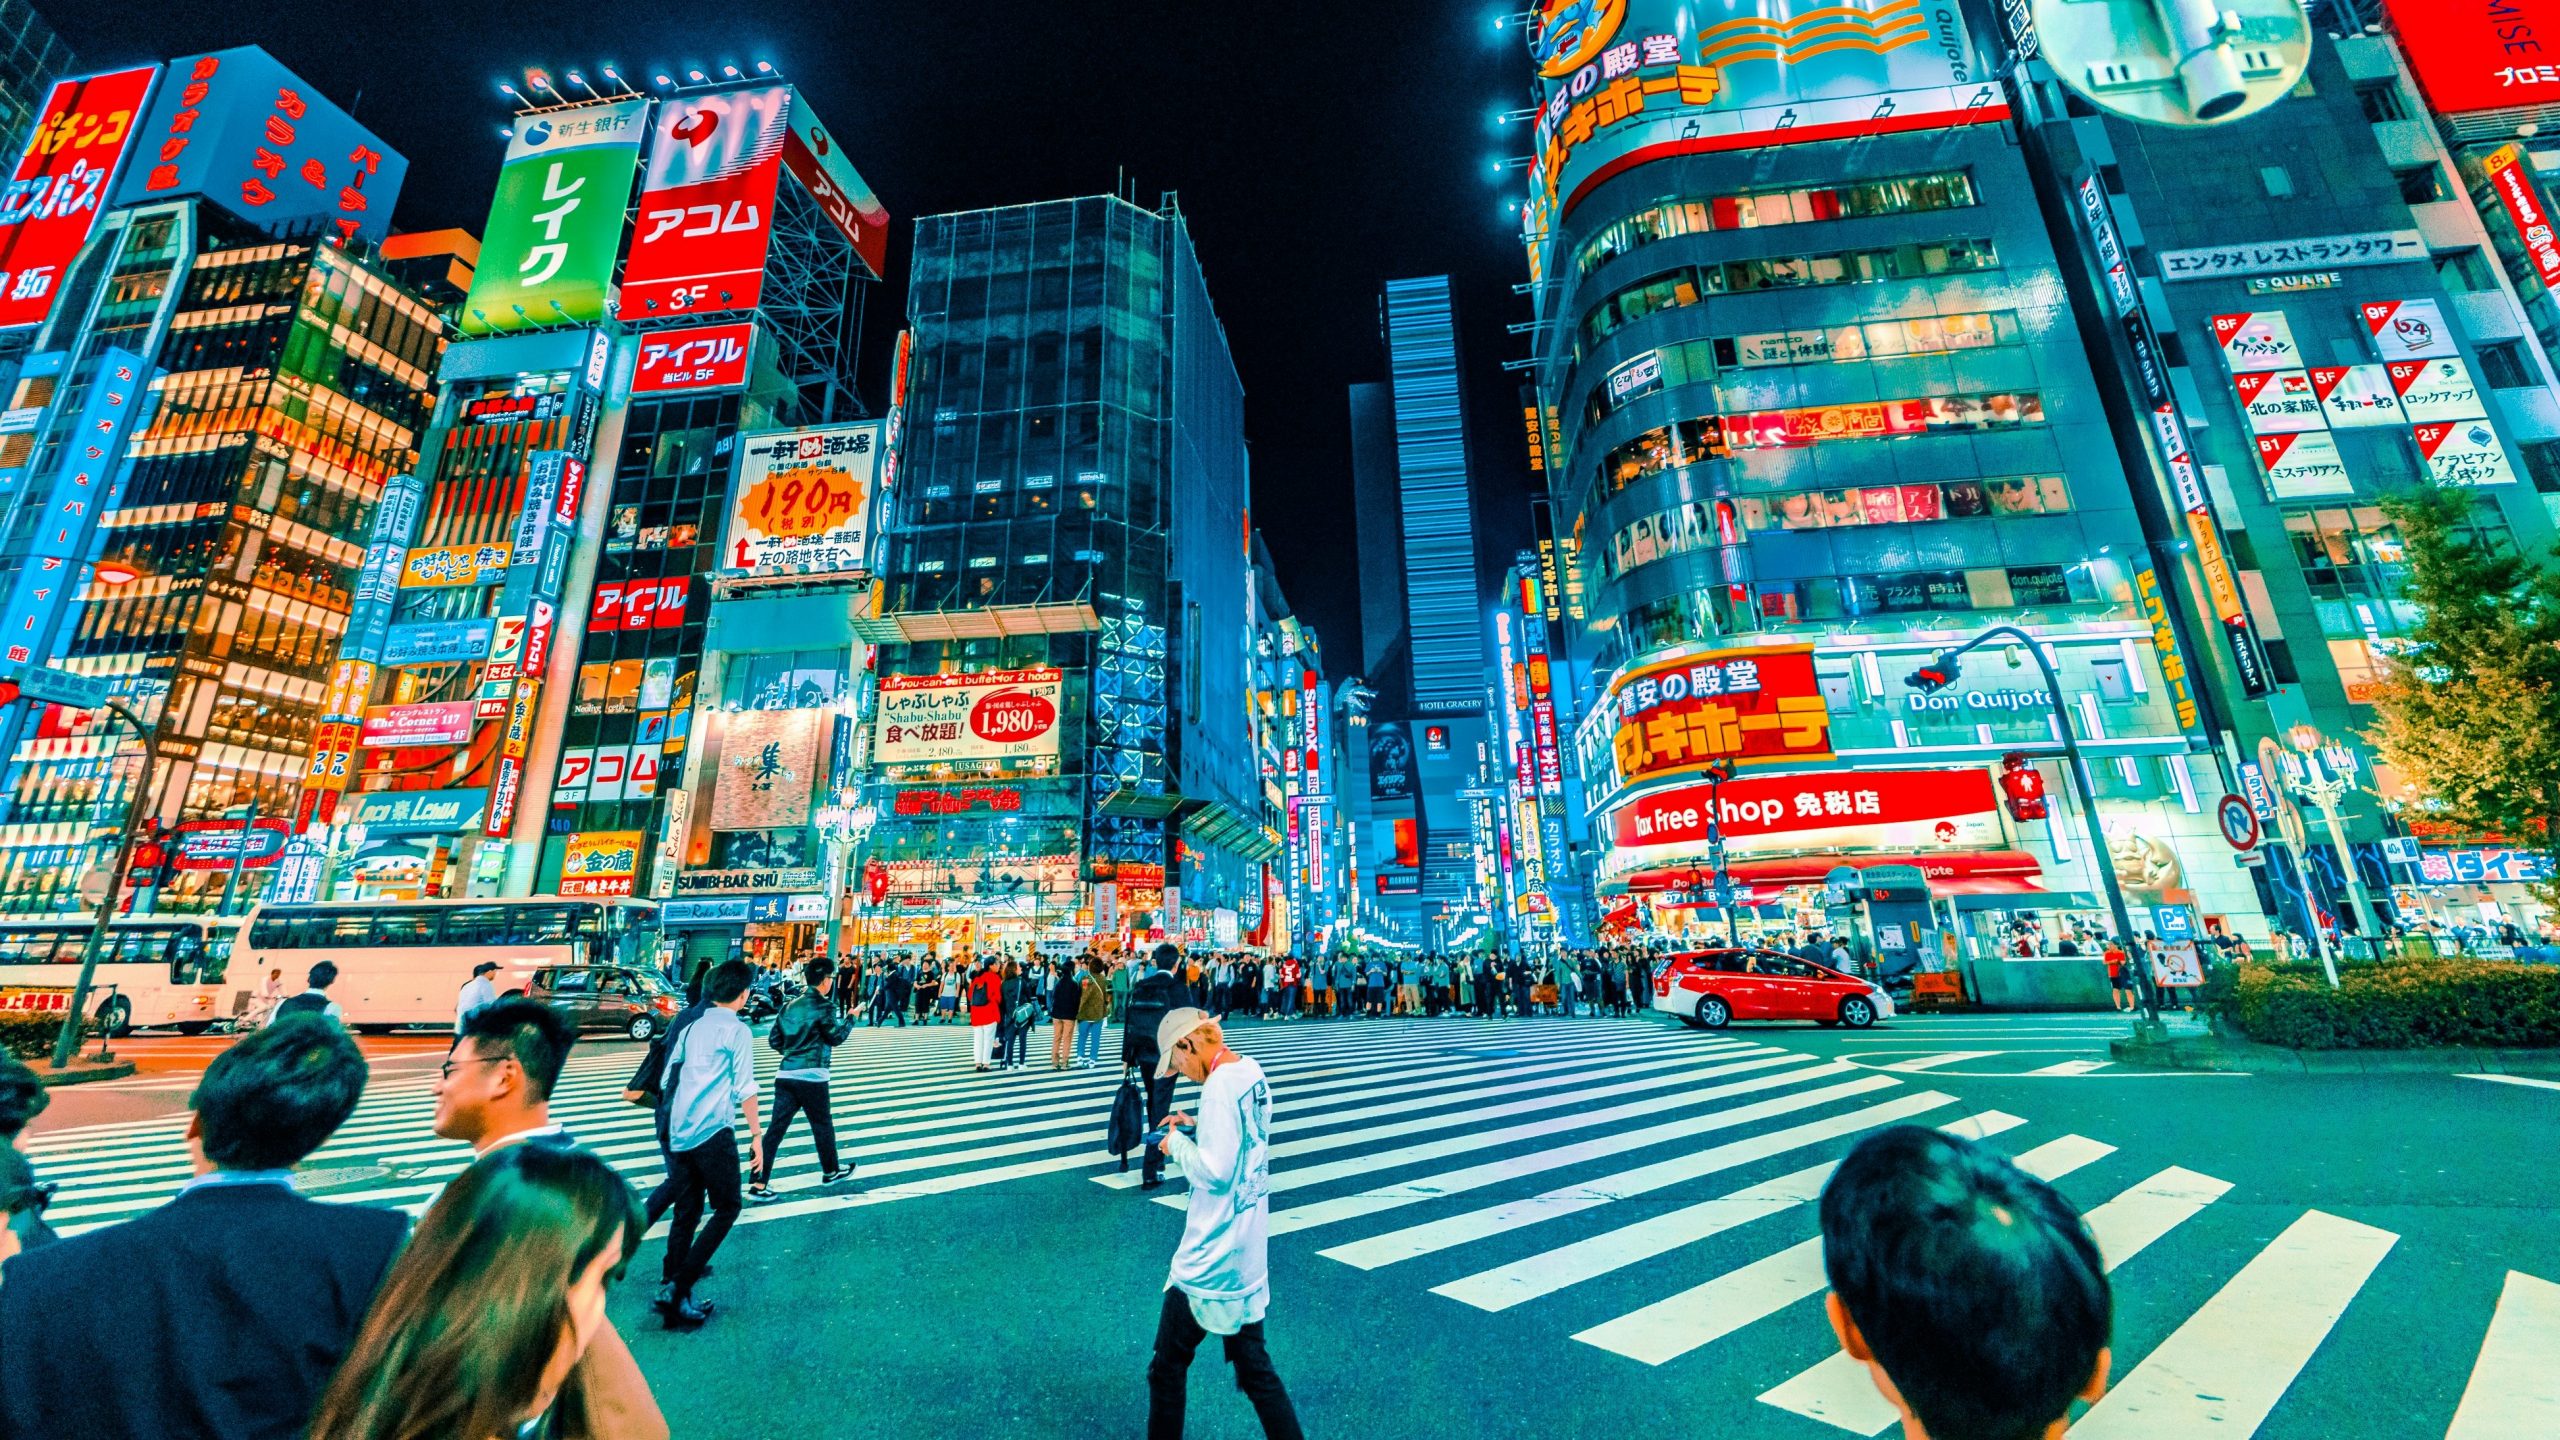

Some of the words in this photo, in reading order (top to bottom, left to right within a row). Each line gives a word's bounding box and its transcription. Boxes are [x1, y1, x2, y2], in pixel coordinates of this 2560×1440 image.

[1936, 9, 1968, 83] Quijote
[1548, 34, 1681, 131] 安の殿堂
[2493, 65, 2560, 87] プロミ
[25, 110, 131, 156] パチンコ
[558, 113, 631, 138] 新生銀行
[242, 87, 307, 205] カラオケ
[301, 158, 327, 189] &
[2490, 152, 2510, 170] 8F
[0, 158, 106, 226] エスパス
[813, 169, 861, 243] アコム
[518, 162, 586, 286] レイク
[643, 200, 760, 244] アコム
[2083, 187, 2115, 261] 6年4組
[2169, 251, 2249, 273] エンタメ
[2254, 238, 2418, 266] レストランタワー
[2255, 272, 2342, 290] SQUARE
[2216, 318, 2239, 332] 8F
[2366, 305, 2389, 320] 9F
[643, 337, 744, 370] アイフル
[1760, 336, 1803, 346] namco
[2232, 337, 2293, 358] クッション
[695, 369, 715, 381] 5F
[2238, 376, 2261, 391] 4F
[2314, 370, 2337, 385] 5F
[2391, 364, 2414, 379] 6F
[2250, 397, 2320, 417] 北の家族
[2405, 388, 2475, 405] ロックアップ
[2260, 437, 2281, 453] B1
[2417, 426, 2441, 442] 2F
[750, 434, 870, 461] 一軒め酒場
[2432, 451, 2503, 468] アラビアン
[2178, 465, 2196, 504] 北の家族
[2272, 463, 2345, 481] ミステリアス
[560, 472, 578, 517] アイフル
[760, 477, 853, 519] 190円
[6, 364, 132, 664] カラオケ&パーティー館
[759, 546, 852, 567] 左の路地を右へ
[2197, 520, 2230, 603] アラビアンロック
[1885, 585, 1921, 596] ブランド
[1928, 582, 1965, 594] 時計
[2011, 573, 2064, 586] don.quijote
[597, 585, 688, 615] アイフル
[630, 615, 647, 628] 5F
[528, 628, 545, 663] アコム
[2136, 570, 2197, 729] ドン・キホーテ
[2235, 632, 2259, 688] ミステリアス
[884, 677, 963, 690] All-you-can-eat
[965, 674, 996, 685] buffet
[1017, 674, 1025, 683] 2
[1027, 671, 1060, 682] hours
[1619, 659, 1762, 717] 驚安の殿堂
[886, 690, 970, 711] しゃぶしゃぶ
[1420, 701, 1448, 710] HOTEL
[1449, 699, 1483, 710] GRACERY
[1909, 693, 1959, 711] Don
[372, 717, 394, 729] The
[398, 715, 438, 728] Corner
[441, 714, 460, 726] 117
[508, 701, 527, 741] 金の蔵
[981, 709, 1034, 737] 1,980
[1304, 688, 1318, 753] SHIDAX
[453, 730, 466, 741] 4F
[885, 722, 965, 745] 食べ放題!
[508, 743, 521, 754] 2F
[560, 753, 658, 786] アコム
[958, 760, 999, 770] USAGIYA
[1034, 755, 1056, 769] 5F
[490, 760, 513, 830] 東京チカラめし
[563, 791, 579, 800] 3F
[2248, 778, 2275, 820] ダイコク
[1310, 805, 1319, 826] RUG
[1635, 809, 1654, 838] Tax
[1655, 804, 1698, 832] Free
[1704, 795, 1785, 828] Shop
[1794, 790, 1881, 817] 免税店
[1547, 821, 1565, 874] カラオケ
[584, 848, 634, 873] 金の蔵
[2421, 853, 2454, 881] 薬
[2457, 850, 2556, 881] ダイコ
[585, 878, 631, 894] 焼き牛丼
[678, 875, 748, 890] SUMIBI-BAR
[1570, 902, 1584, 940] カラオケ
